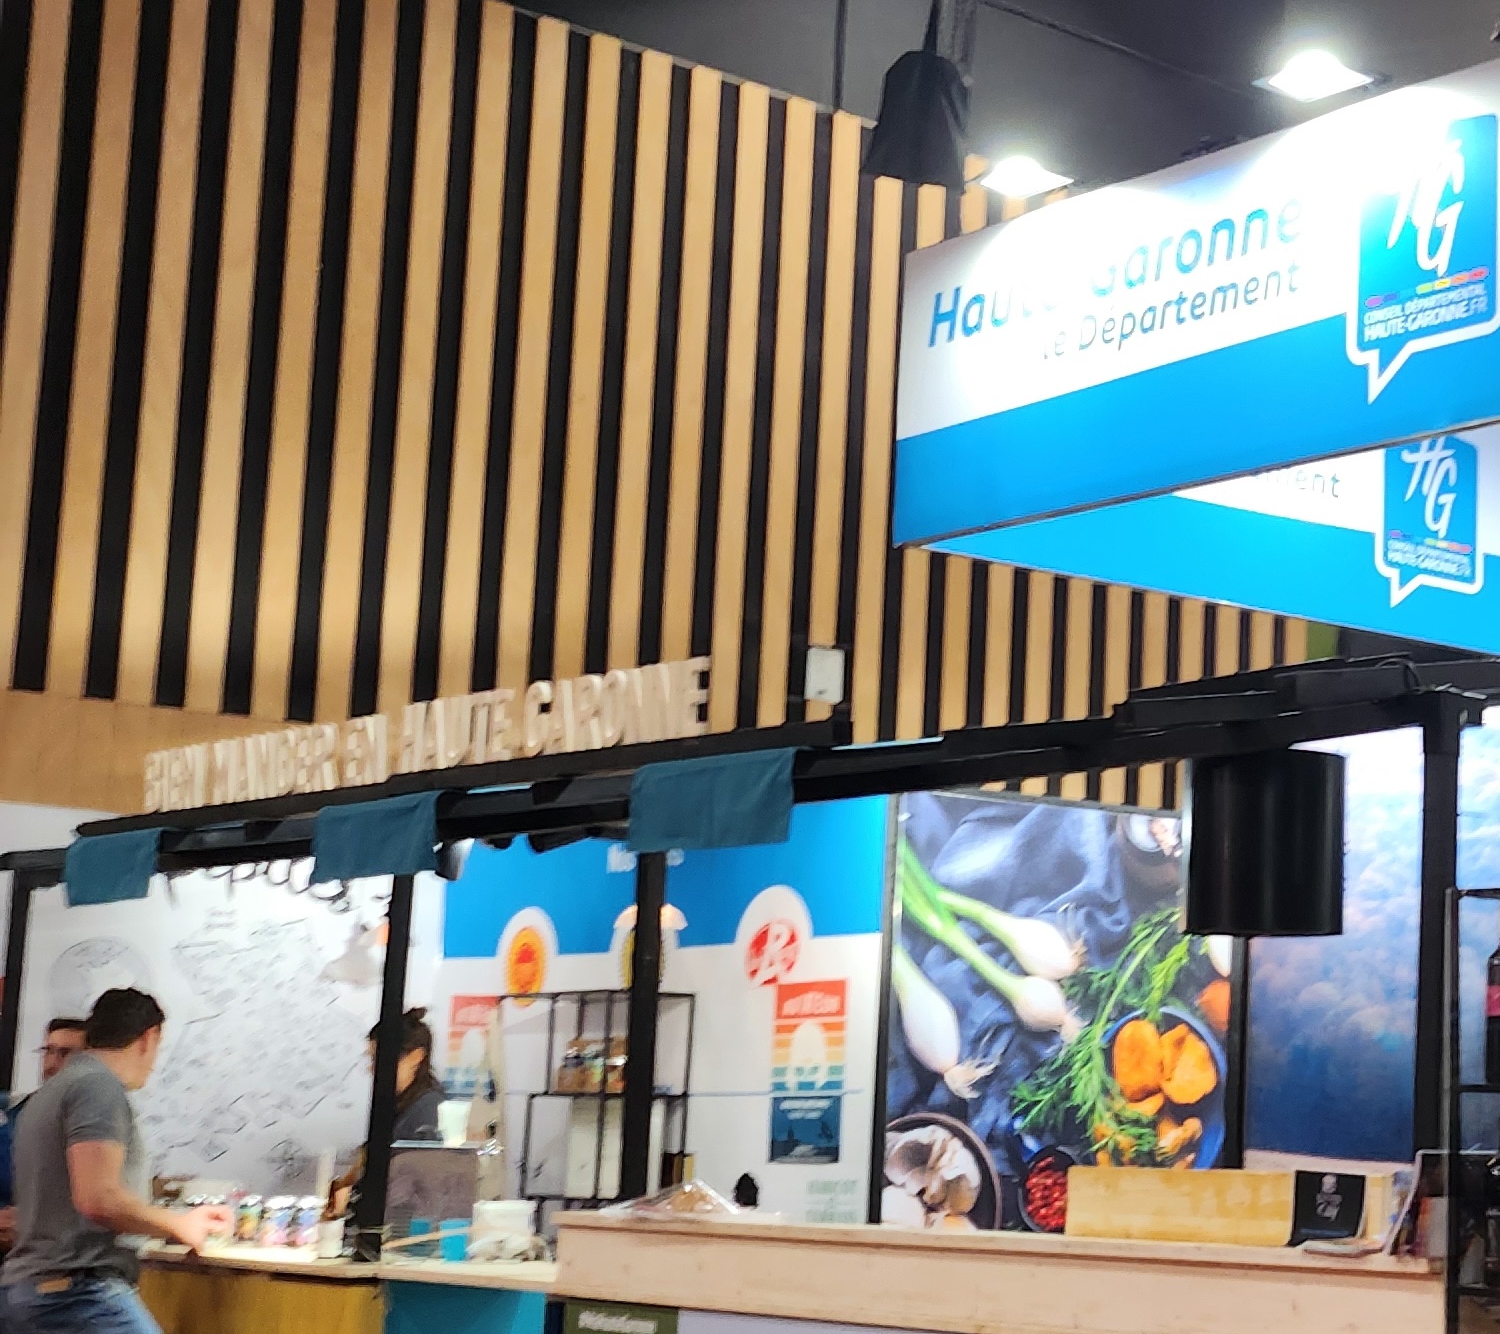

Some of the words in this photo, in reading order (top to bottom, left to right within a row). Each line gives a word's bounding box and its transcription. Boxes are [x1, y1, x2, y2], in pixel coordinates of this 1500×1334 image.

[1079, 259, 1300, 351] Département
[144, 742, 208, 814] BIEN
[213, 723, 340, 806] MANGER
[344, 713, 389, 788] EN
[401, 687, 516, 774] HAUTE
[525, 655, 711, 757] GARONNE
